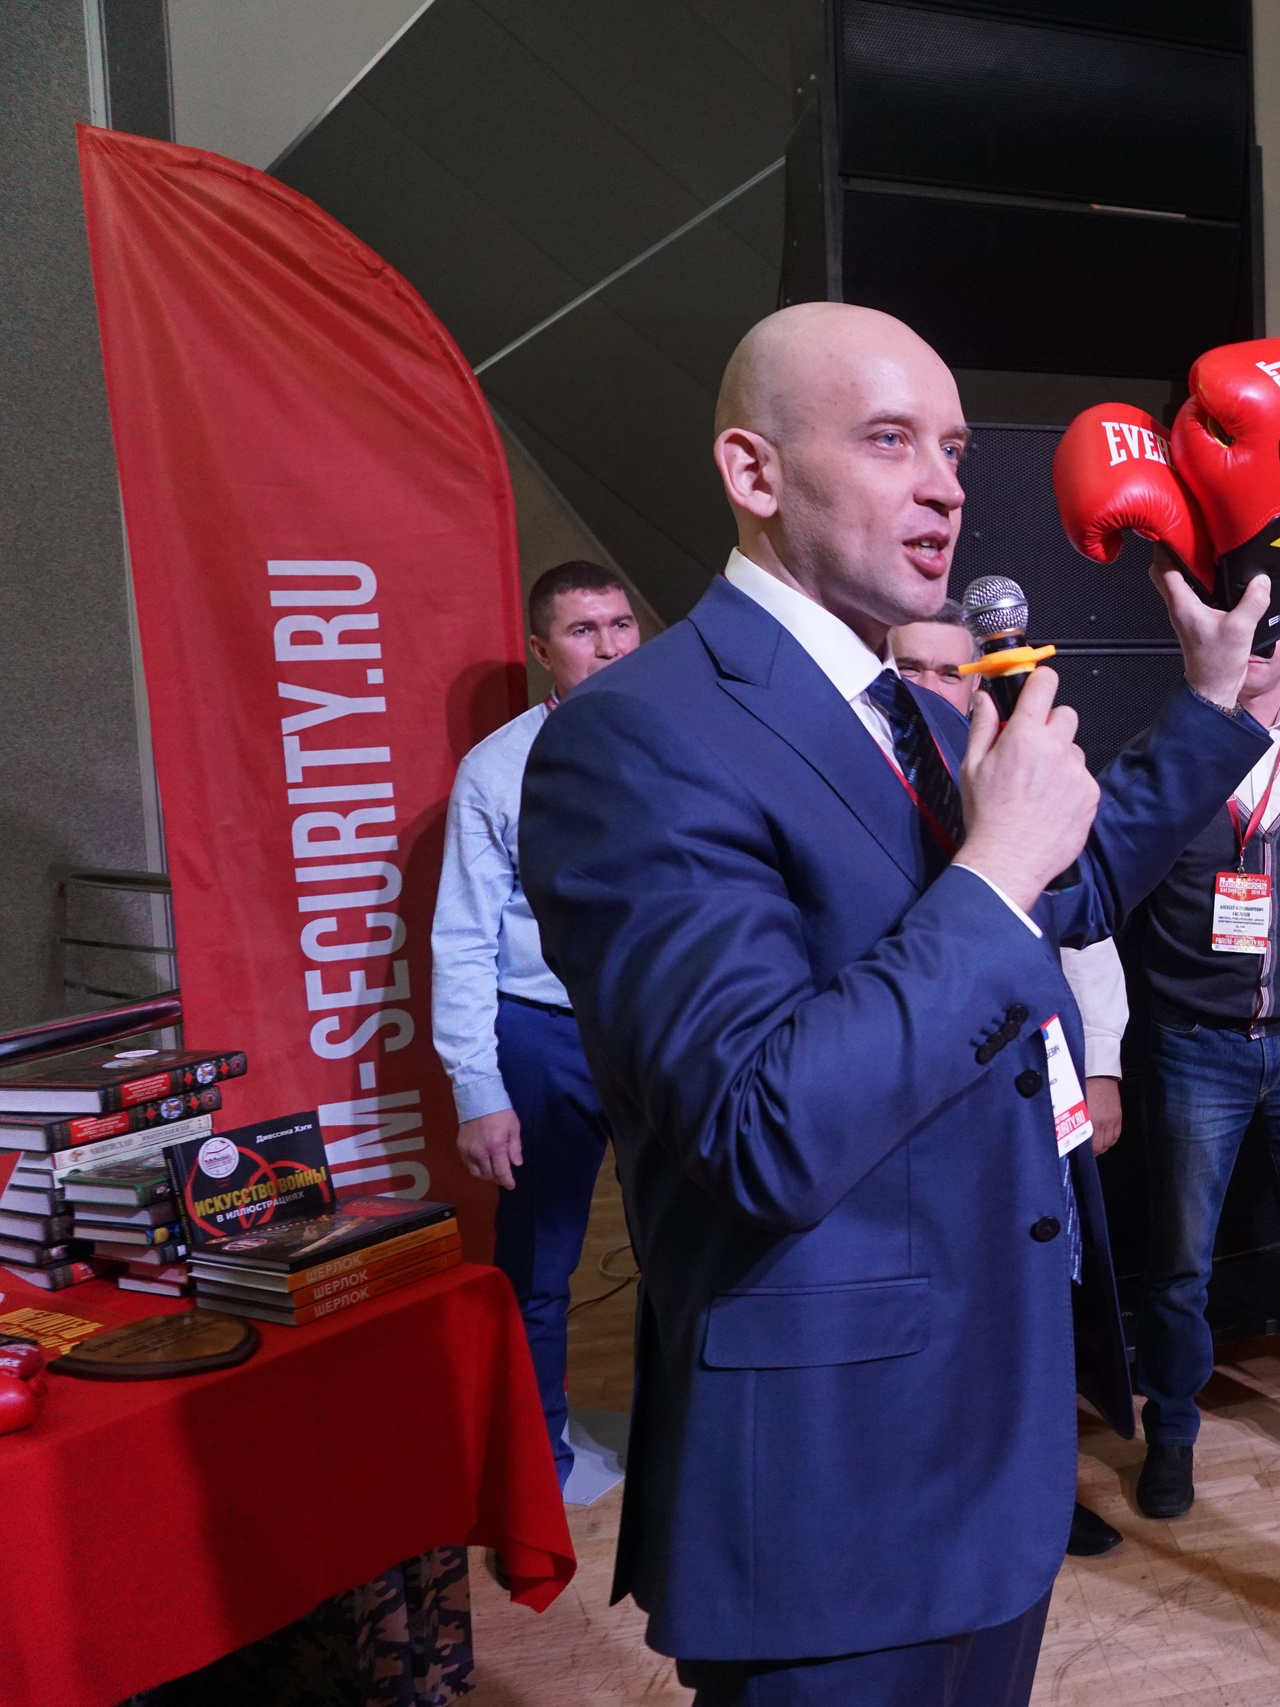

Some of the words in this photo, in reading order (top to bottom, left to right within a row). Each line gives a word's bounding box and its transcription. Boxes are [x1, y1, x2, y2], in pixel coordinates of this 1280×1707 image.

[1101, 421, 1174, 470] EVER
[256, 1130, 294, 1144] Джессика
[294, 1123, 312, 1133] Хэги
[194, 1181, 276, 1217] ИСКУССТВО
[279, 1166, 327, 1192] ВОЙНЫ
[216, 1214, 224, 1223] В
[226, 1191, 304, 1219] ИЛЛЮСТРАЦИЯХ
[306, 1255, 363, 1283] ШЕРЛОК
[313, 1270, 368, 1300] ШЕРЛОК
[314, 1286, 369, 1318] ШЕРЛОК
